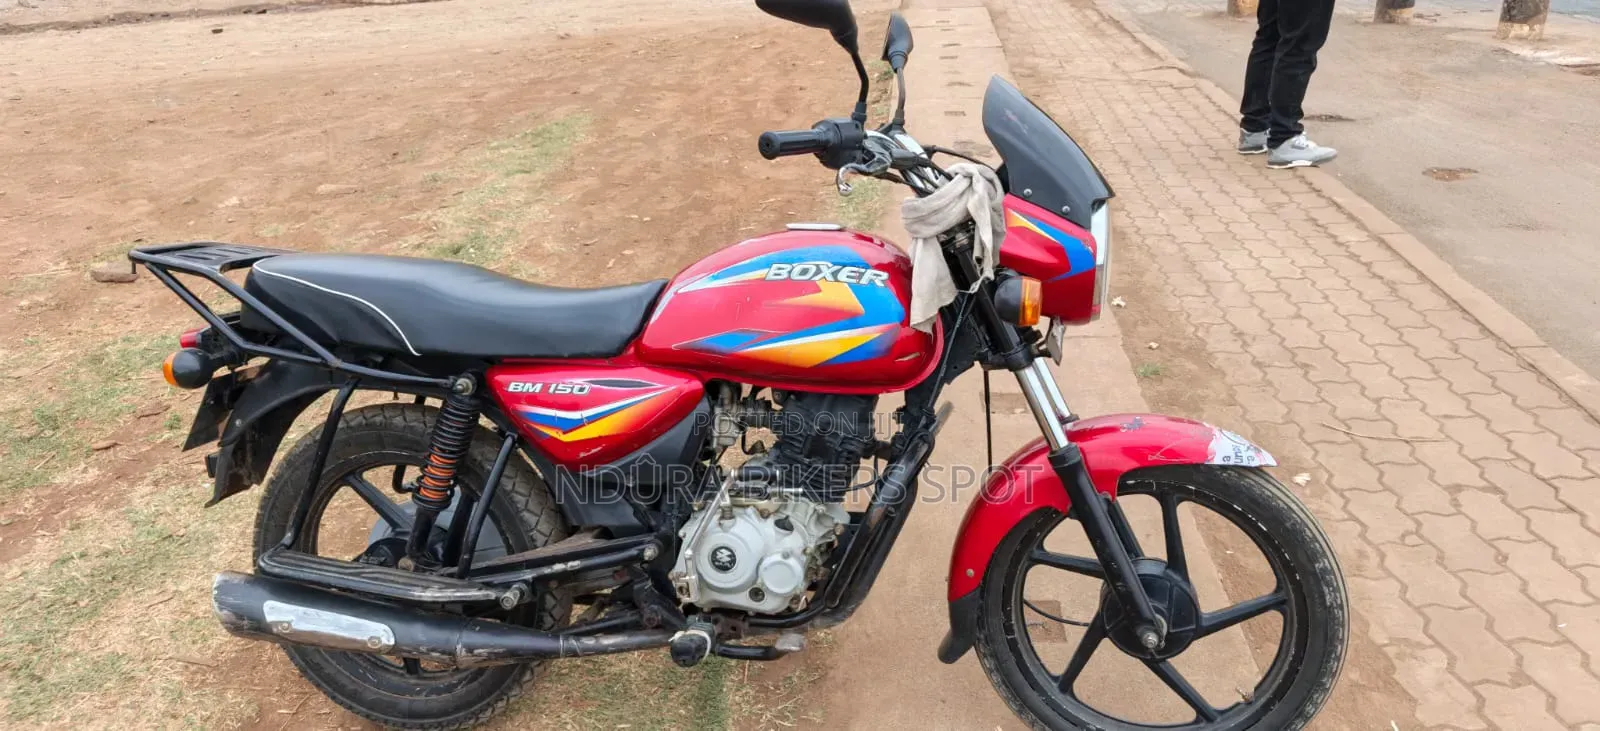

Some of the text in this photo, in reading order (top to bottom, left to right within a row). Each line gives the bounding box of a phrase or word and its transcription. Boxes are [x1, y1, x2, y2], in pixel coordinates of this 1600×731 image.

[765, 263, 890, 287] BOXER
[507, 382, 592, 395] BM 150
